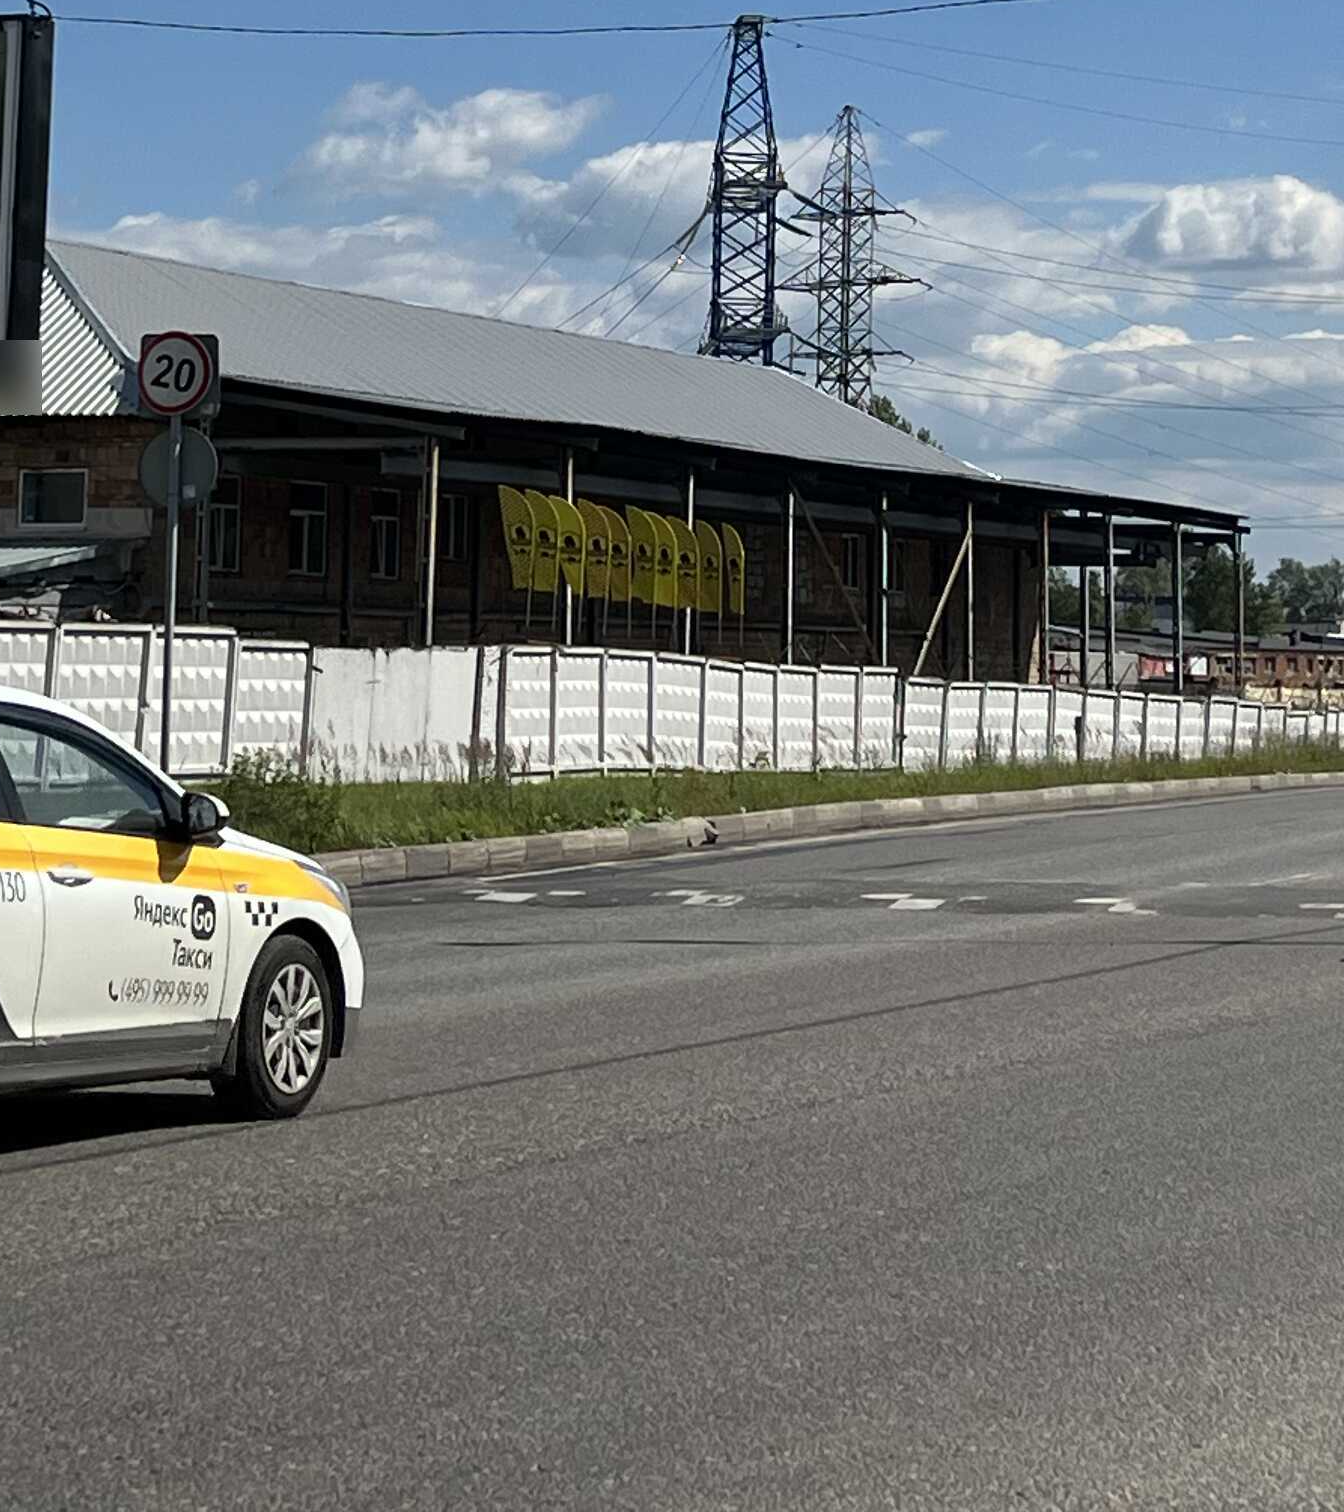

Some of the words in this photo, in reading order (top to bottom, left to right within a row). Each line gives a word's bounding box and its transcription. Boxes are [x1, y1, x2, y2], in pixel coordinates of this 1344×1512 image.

[150, 354, 196, 392] 20
[133, 895, 189, 928] Яндекс
[192, 901, 214, 933] Go
[172, 938, 213, 970] Такси
[120, 978, 151, 1003] (495)
